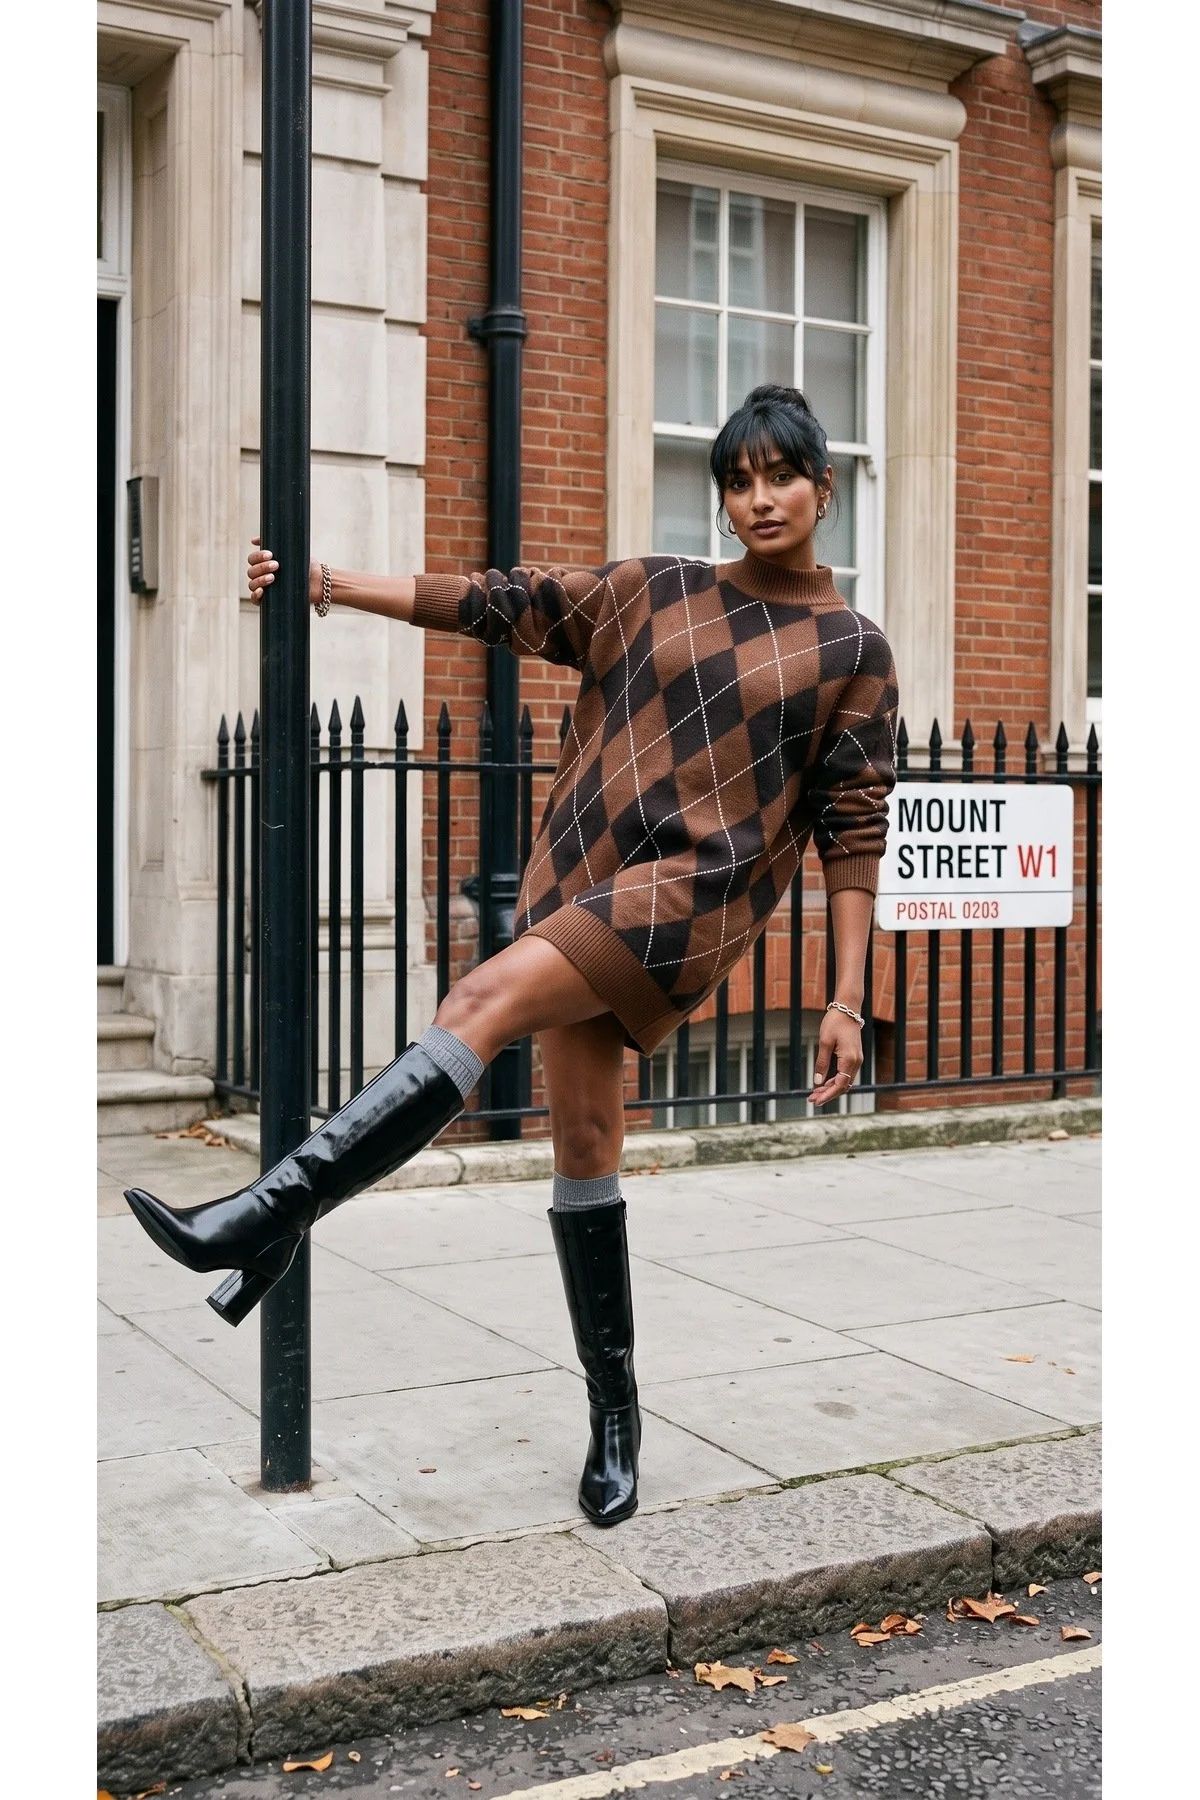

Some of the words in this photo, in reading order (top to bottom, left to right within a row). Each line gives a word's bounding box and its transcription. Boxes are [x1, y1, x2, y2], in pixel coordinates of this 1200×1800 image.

[898, 798, 1006, 833] MOUNT
[897, 844, 1008, 879] STREET
[1017, 844, 1057, 878] W1
[896, 901, 957, 921] POSTAL
[962, 901, 999, 919] 0203
